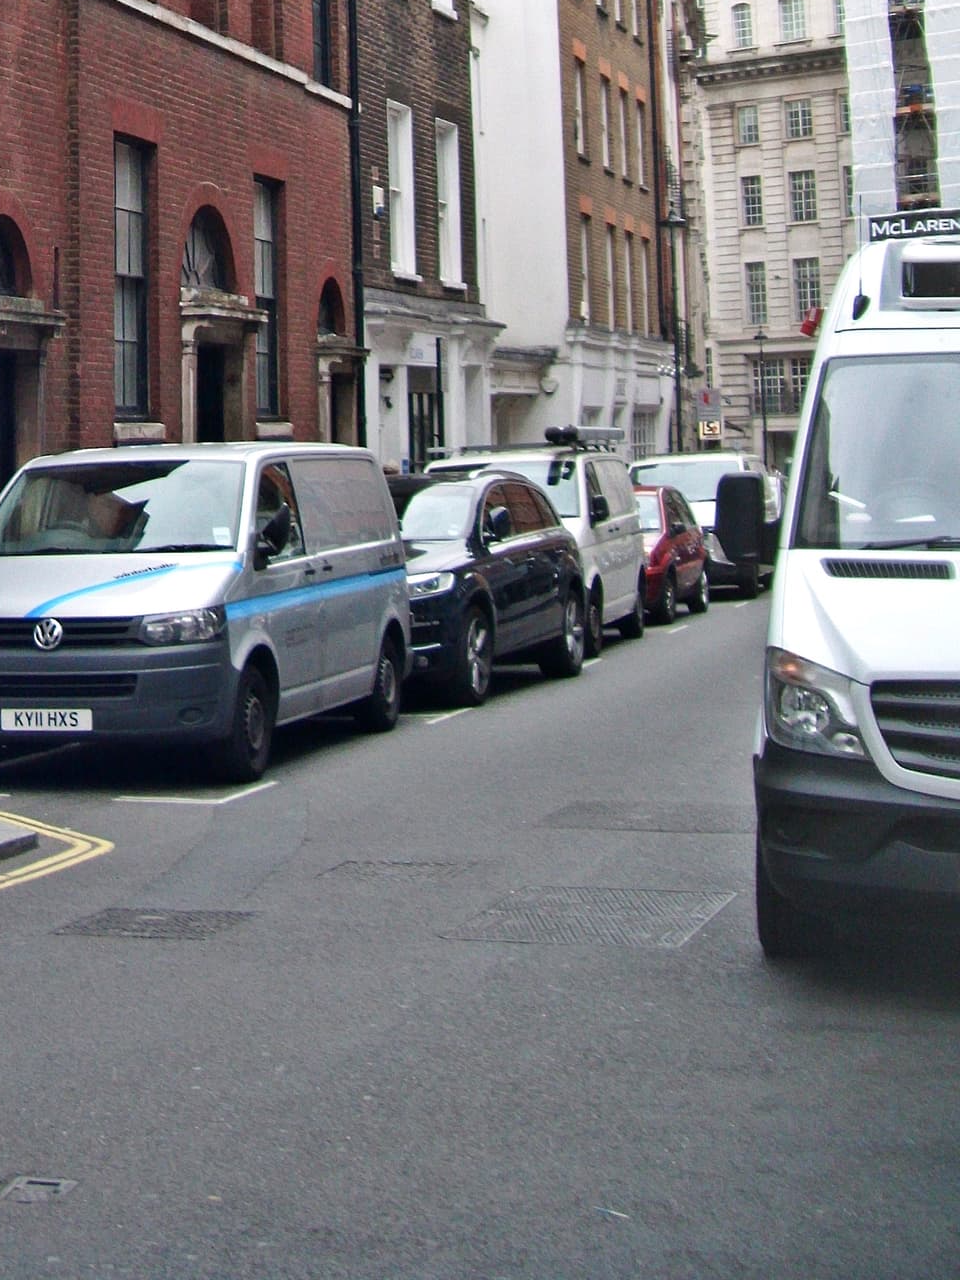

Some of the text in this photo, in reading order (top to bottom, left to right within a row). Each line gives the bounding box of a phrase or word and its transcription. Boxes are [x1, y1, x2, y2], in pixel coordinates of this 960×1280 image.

[871, 218, 960, 237] McLAREN
[14, 711, 79, 727] KY11 HXS
